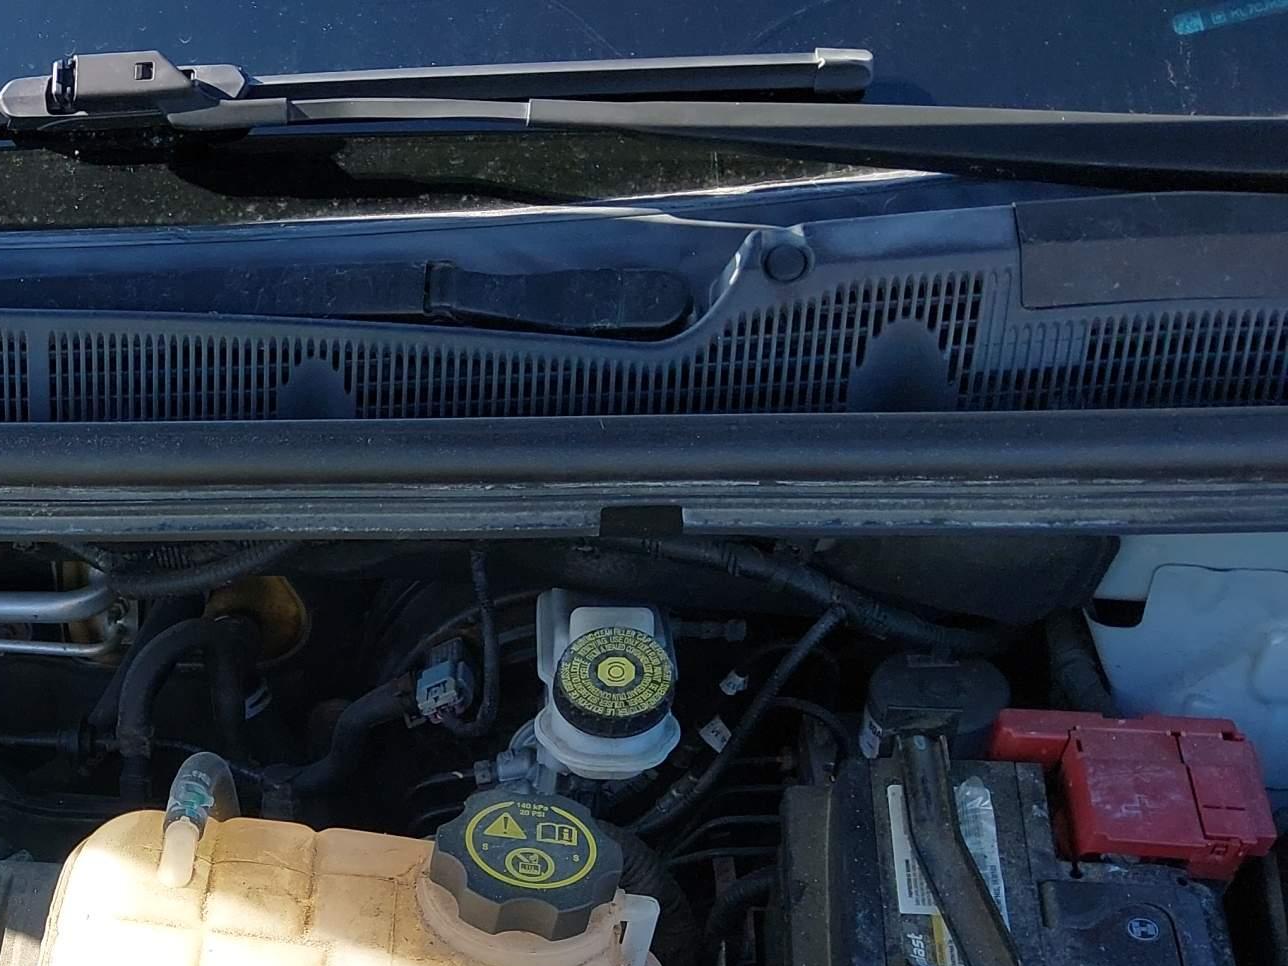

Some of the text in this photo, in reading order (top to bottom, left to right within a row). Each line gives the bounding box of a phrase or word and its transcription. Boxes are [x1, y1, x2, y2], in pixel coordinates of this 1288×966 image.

[517, 802, 549, 812] 140 kPa
[519, 809, 546, 818] 20 PSI
